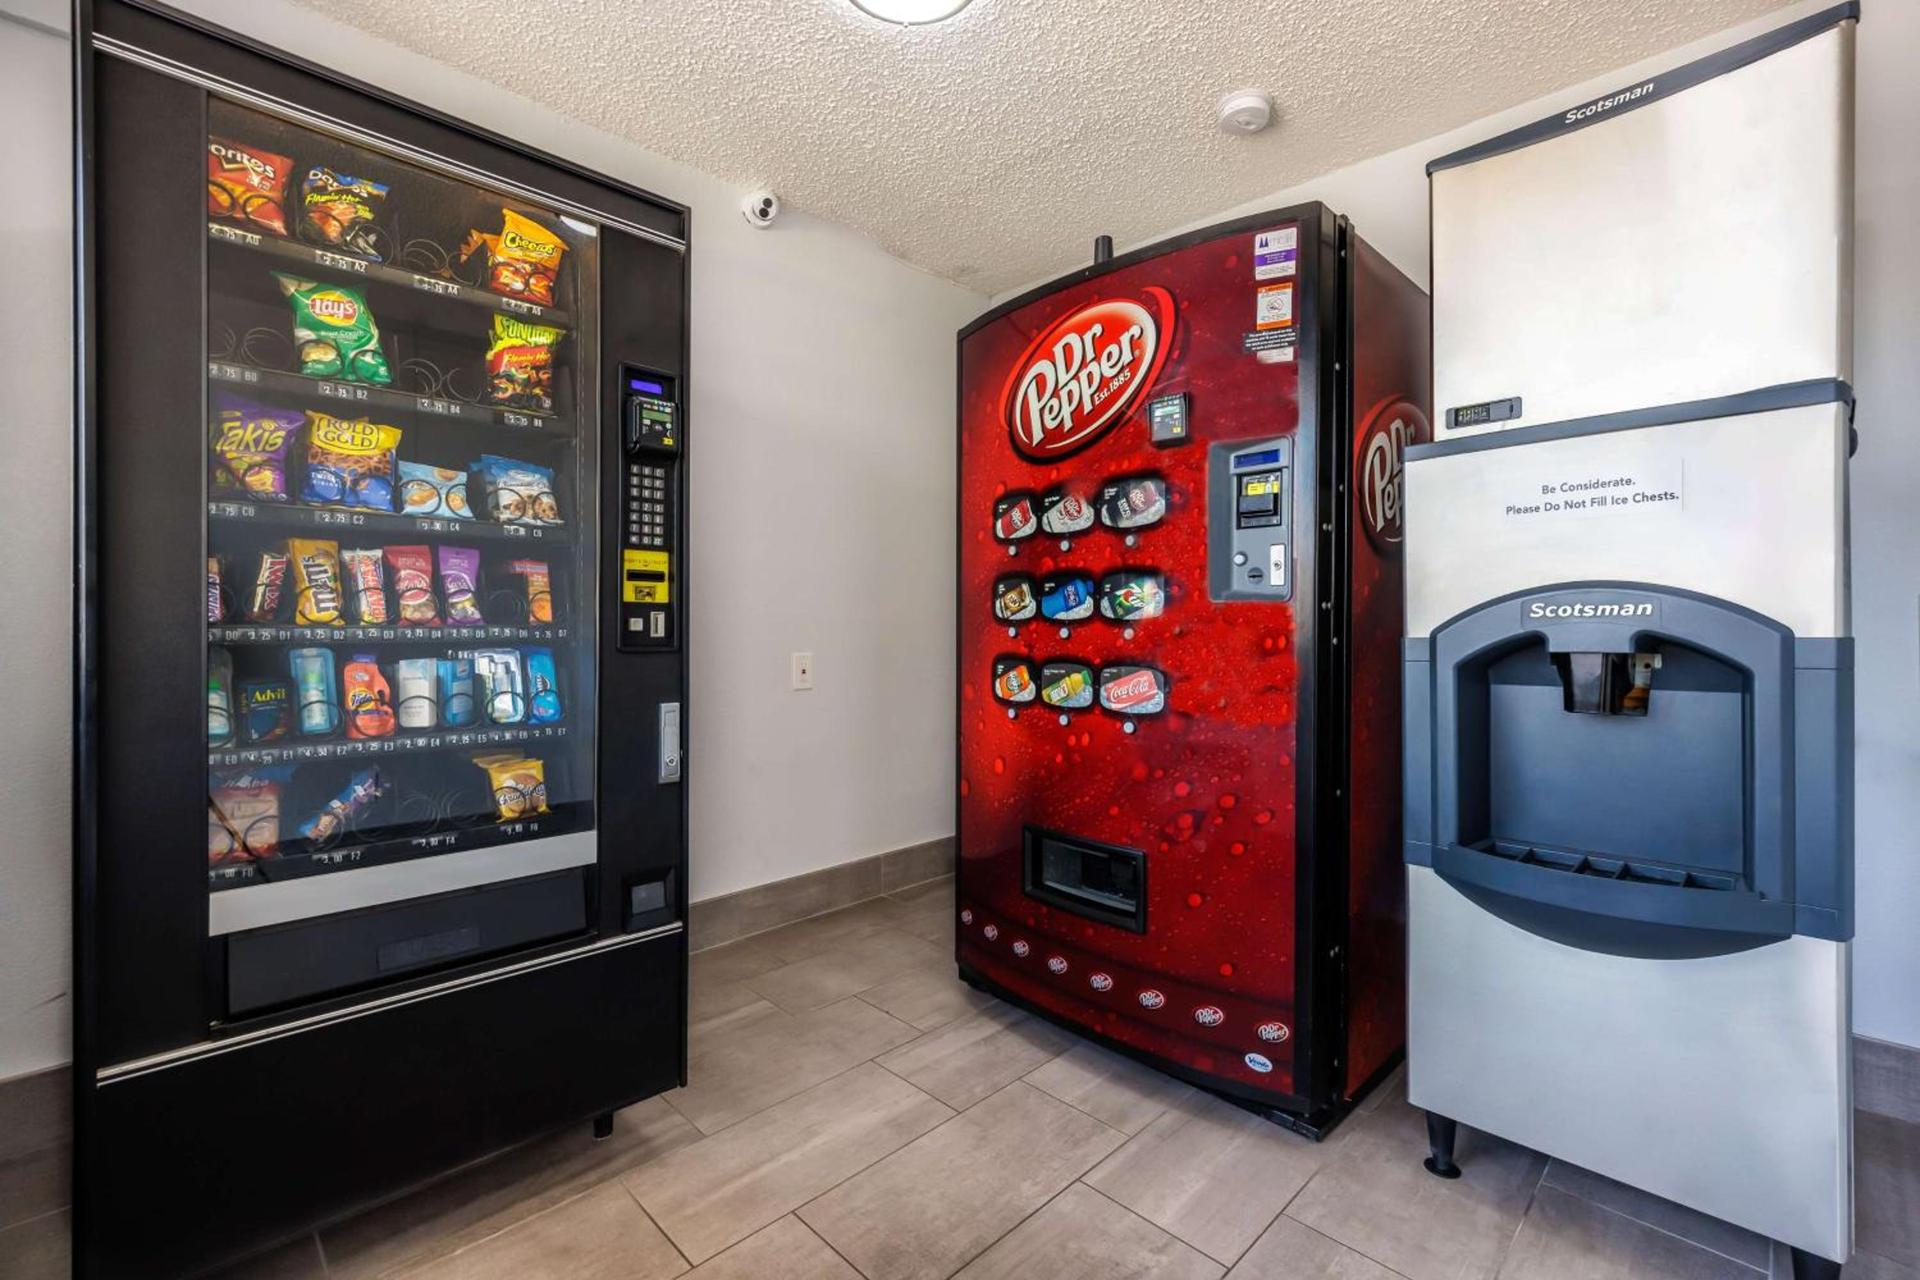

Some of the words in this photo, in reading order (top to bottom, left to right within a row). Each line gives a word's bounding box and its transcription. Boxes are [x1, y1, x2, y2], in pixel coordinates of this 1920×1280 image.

[1565, 82, 1655, 124] Scotsman
[208, 143, 276, 180] oritos
[1052, 323, 1103, 391] Dr
[1015, 324, 1142, 448] Pepper
[215, 418, 286, 455] Takis
[323, 430, 373, 448] GOLD
[327, 418, 374, 436] ROLD
[1364, 431, 1403, 533] Pep
[1541, 484, 1557, 495] Be
[1560, 476, 1636, 494] Considerate.
[1506, 505, 1541, 516] Please
[1544, 502, 1561, 513] Do
[1564, 500, 1586, 511] Not
[1590, 496, 1608, 508] Fill
[1611, 495, 1628, 506] Ice
[1632, 490, 1680, 504] Chests.
[1529, 602, 1653, 618] Scotsman
[253, 687, 288, 704] Advil
[351, 693, 373, 708] Tide
